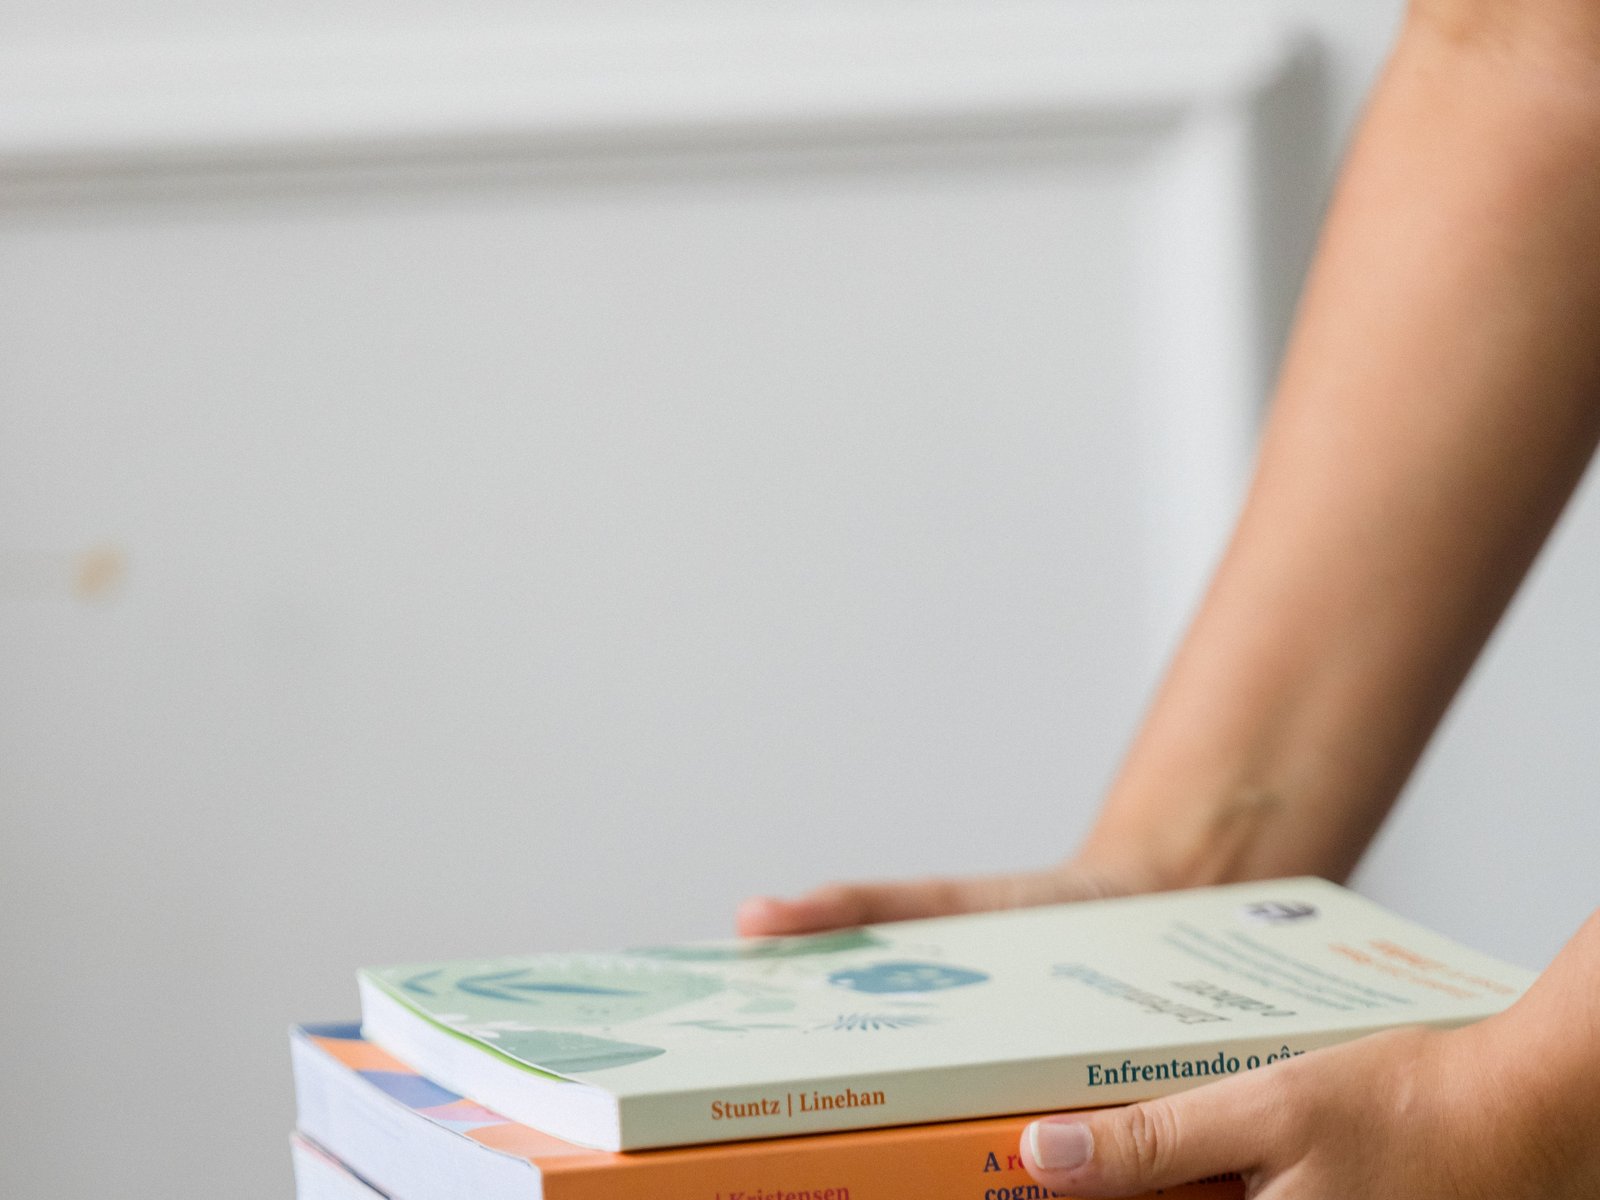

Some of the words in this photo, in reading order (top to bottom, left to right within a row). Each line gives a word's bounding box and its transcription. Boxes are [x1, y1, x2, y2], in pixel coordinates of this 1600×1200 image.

[1087, 1052, 1240, 1087] Enfrentando
[1246, 1055, 1260, 1070] o
[711, 1096, 781, 1120] Stuntz
[800, 1088, 886, 1112] Linehan
[983, 1151, 1002, 1172] A
